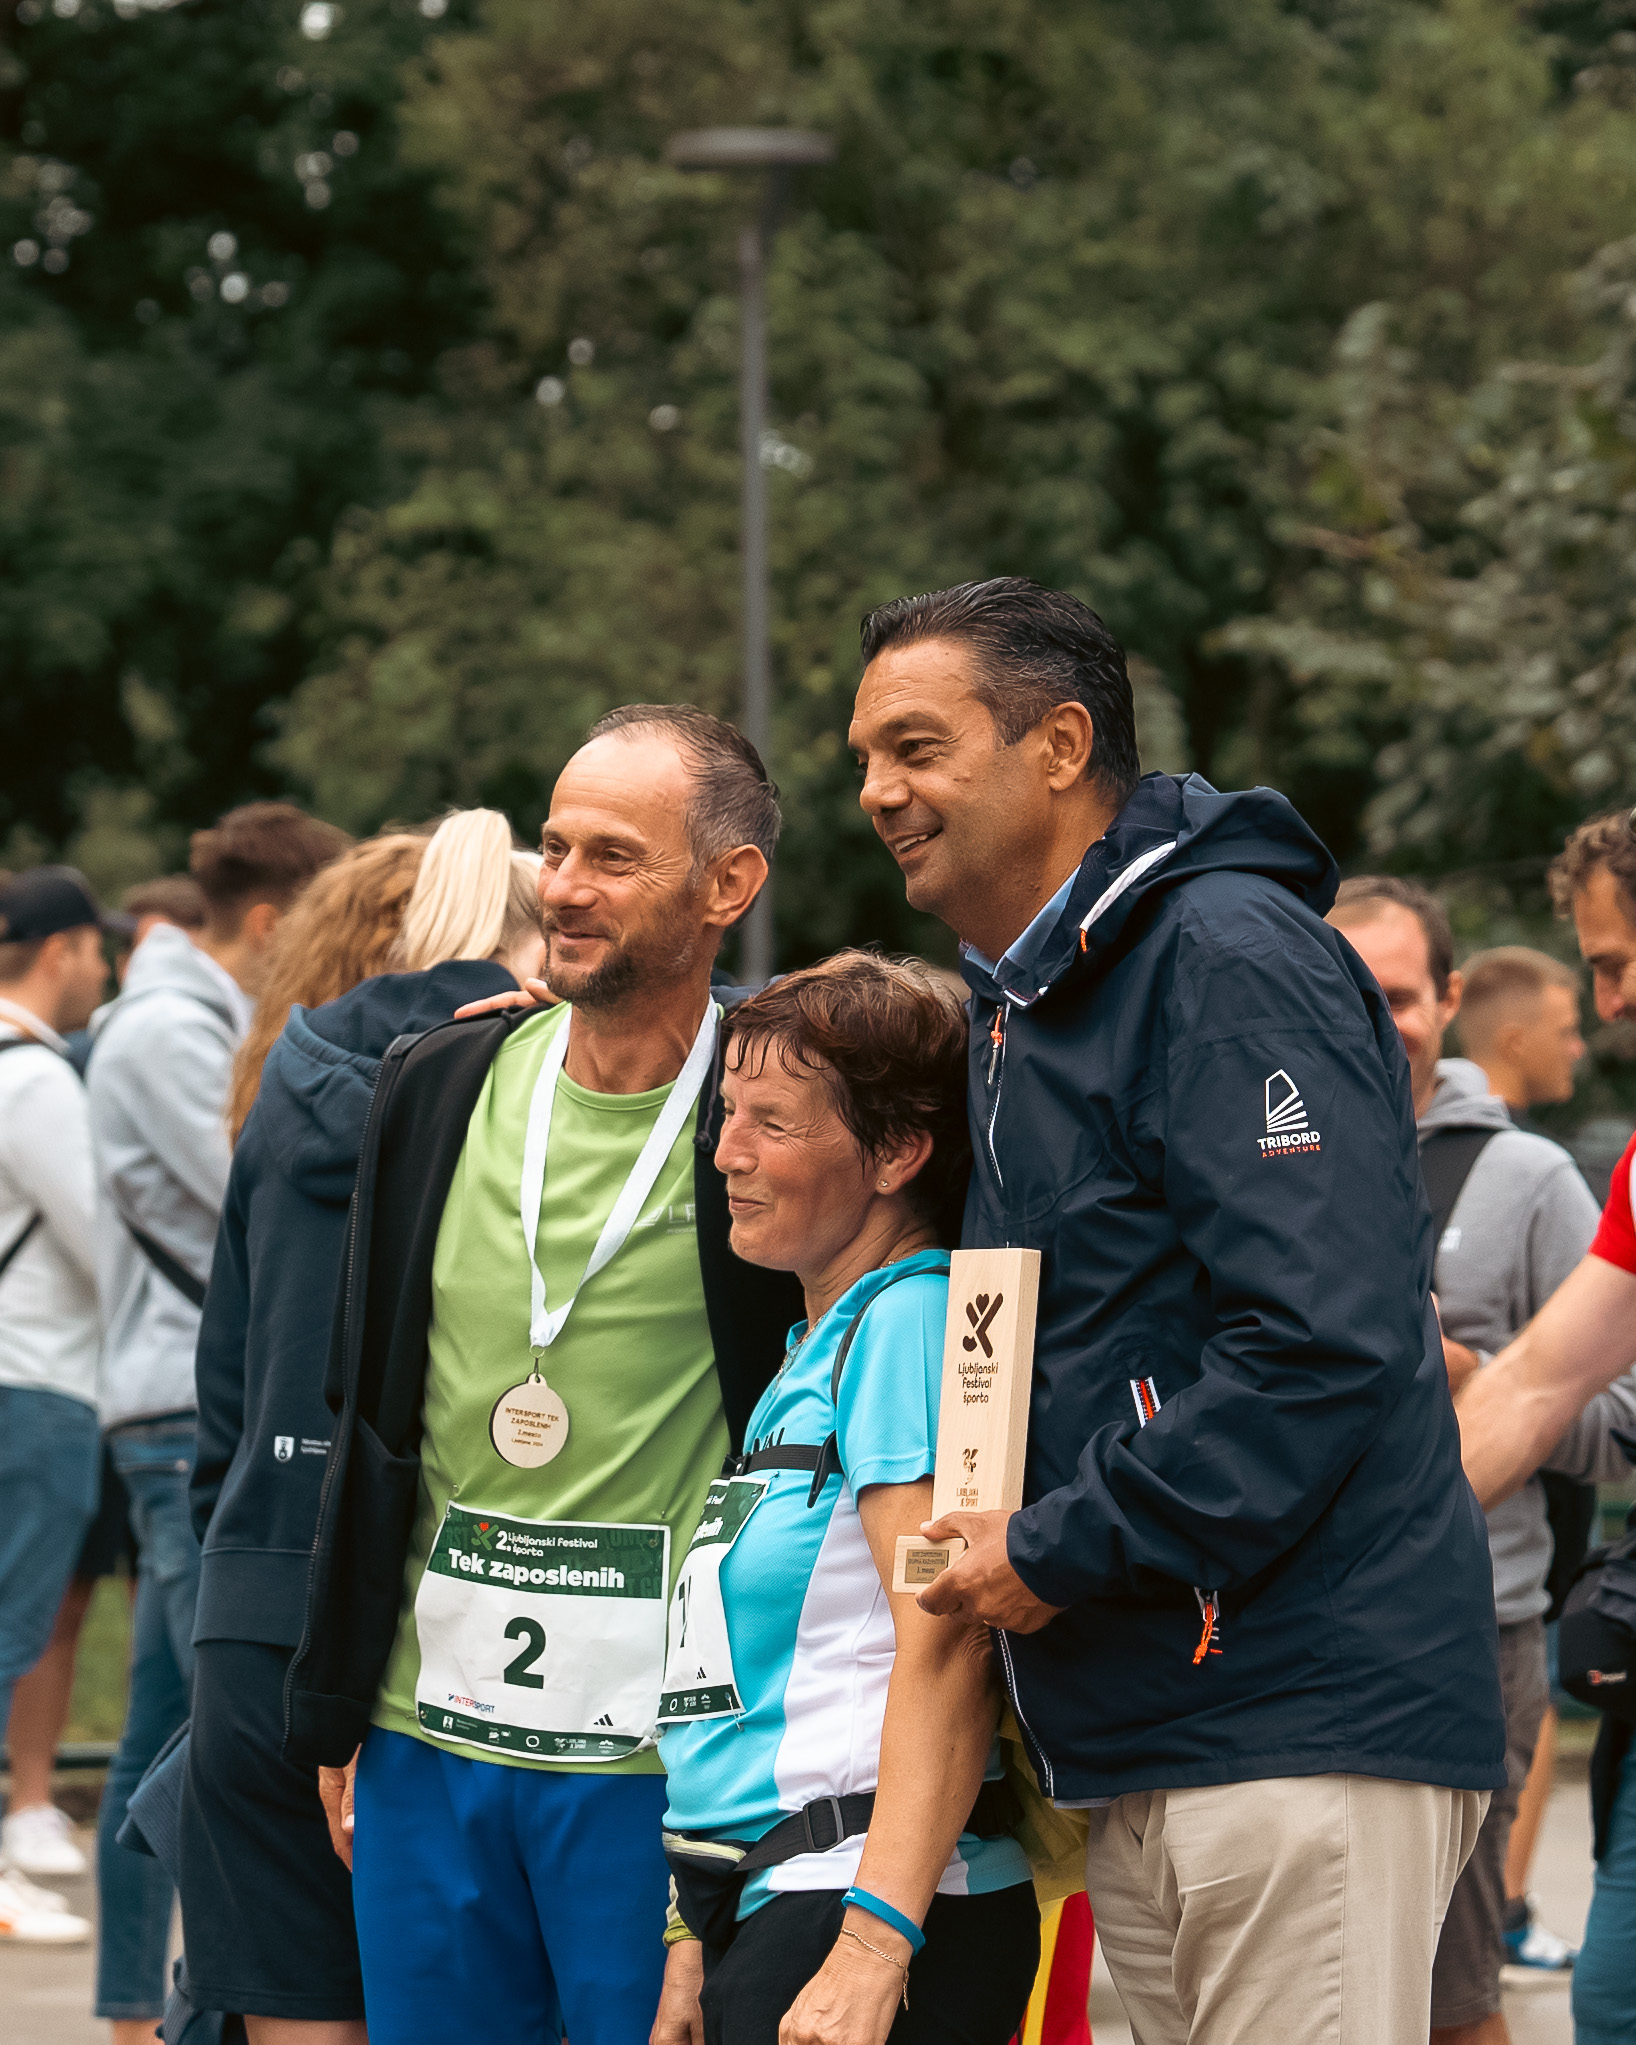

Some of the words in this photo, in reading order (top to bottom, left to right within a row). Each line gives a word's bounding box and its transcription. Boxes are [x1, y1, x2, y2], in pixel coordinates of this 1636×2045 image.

[1257, 1131, 1320, 1150] TRIBORD
[1262, 1144, 1321, 1158] ADVENTURE
[958, 1362, 998, 1377] Ljubljanski
[505, 1407, 545, 1419] INTERSPORT
[547, 1414, 559, 1422] TEK
[508, 1532, 556, 1546] Ljubljanski
[513, 1544, 544, 1557] športa
[449, 1548, 485, 1575] Tek
[489, 1559, 625, 1588] zaposlenih
[503, 1616, 546, 1689] 2
[454, 1695, 495, 1713] INTERSPORT
